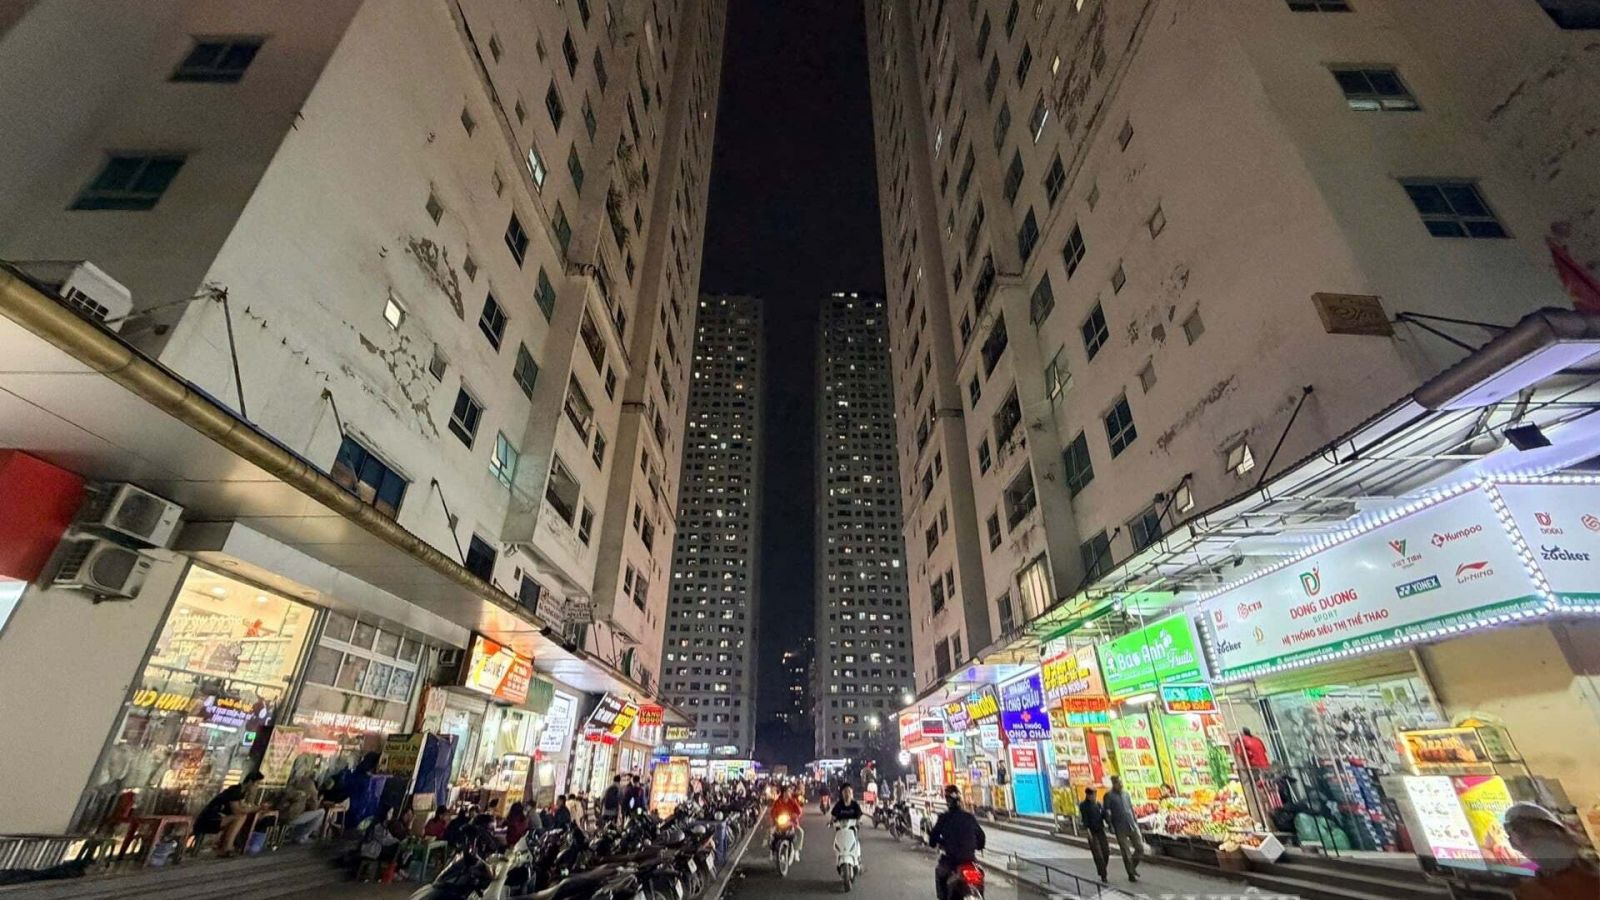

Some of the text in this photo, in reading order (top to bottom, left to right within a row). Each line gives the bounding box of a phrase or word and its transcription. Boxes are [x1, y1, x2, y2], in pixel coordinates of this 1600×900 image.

[1444, 524, 1482, 542] Kumpoo
[1411, 576, 1438, 592] YONEX
[1289, 588, 1358, 620] DONG DUONG
[1364, 608, 1389, 622] THAO
